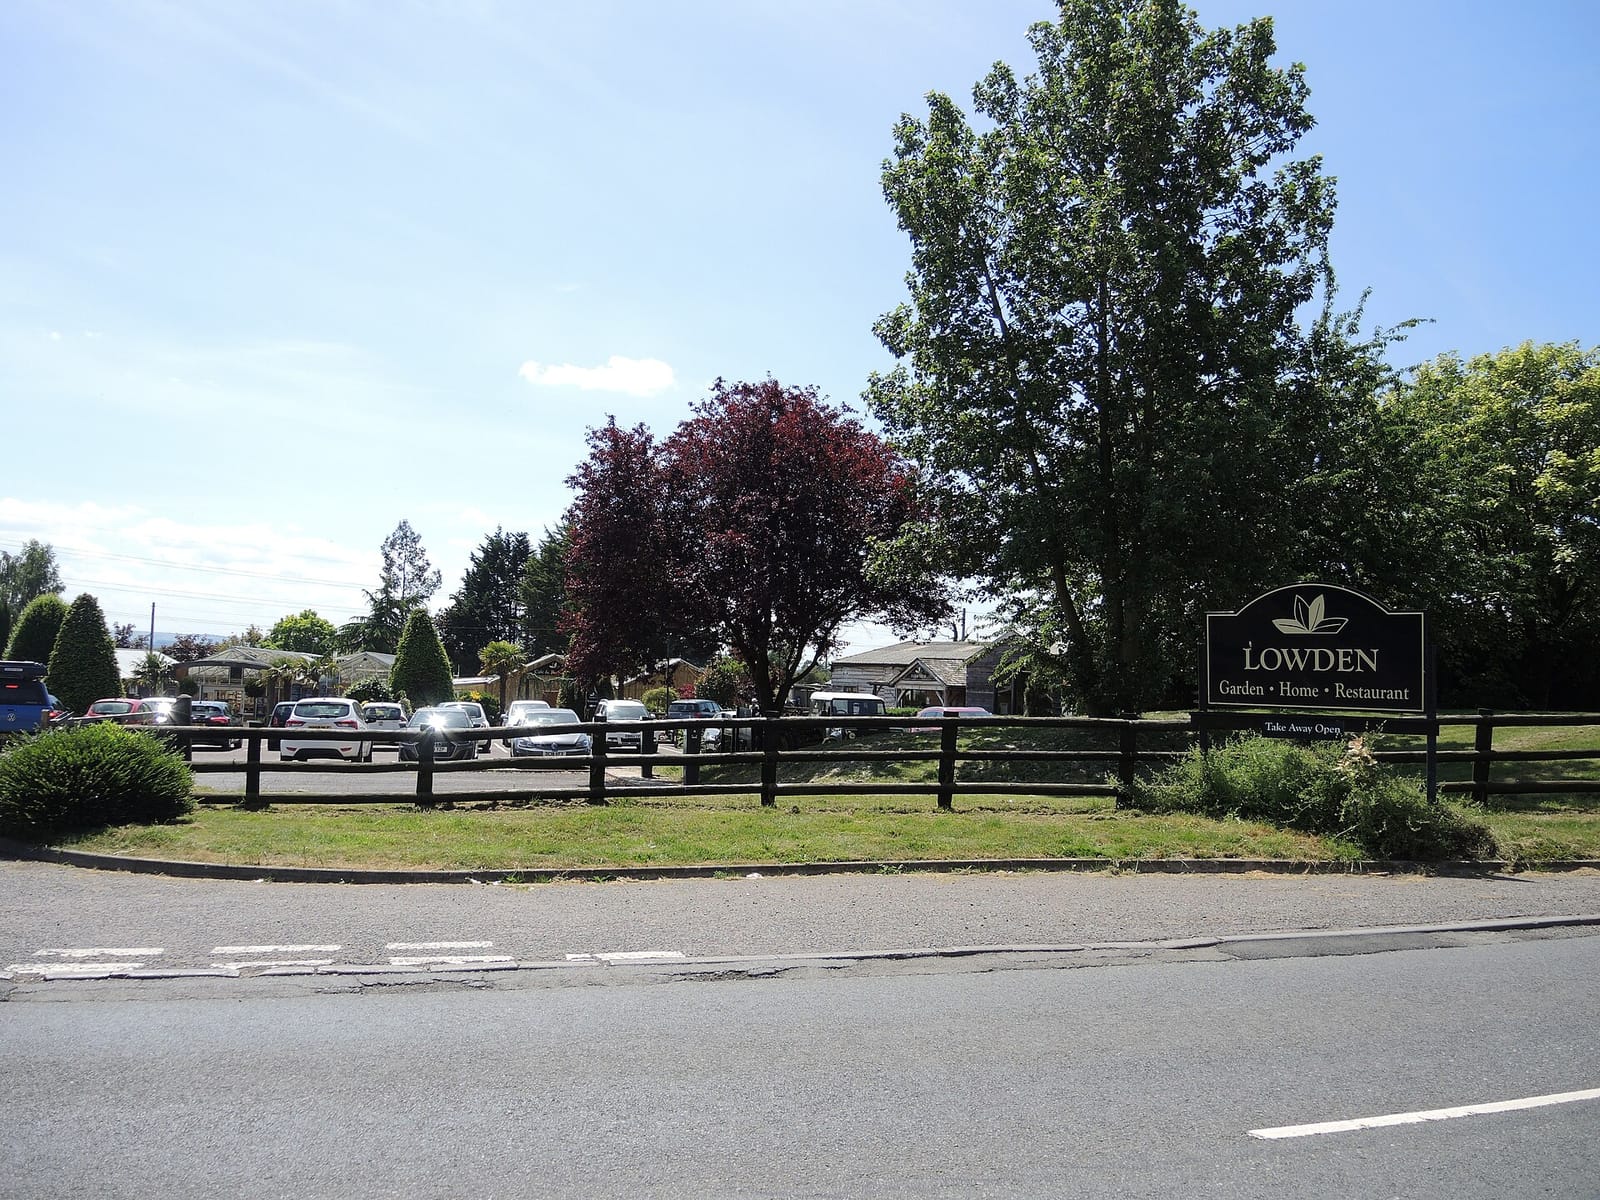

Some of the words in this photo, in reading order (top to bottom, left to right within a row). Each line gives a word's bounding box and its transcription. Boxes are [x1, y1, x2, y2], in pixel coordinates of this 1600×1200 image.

[1243, 646, 1379, 672] LOWDEN
[1219, 679, 1264, 695] Garden
[1279, 681, 1319, 697] Home
[1334, 682, 1409, 700] Restaurant
[1264, 721, 1287, 732] Take
[1288, 723, 1313, 734] Away
[1314, 723, 1341, 735] Open
